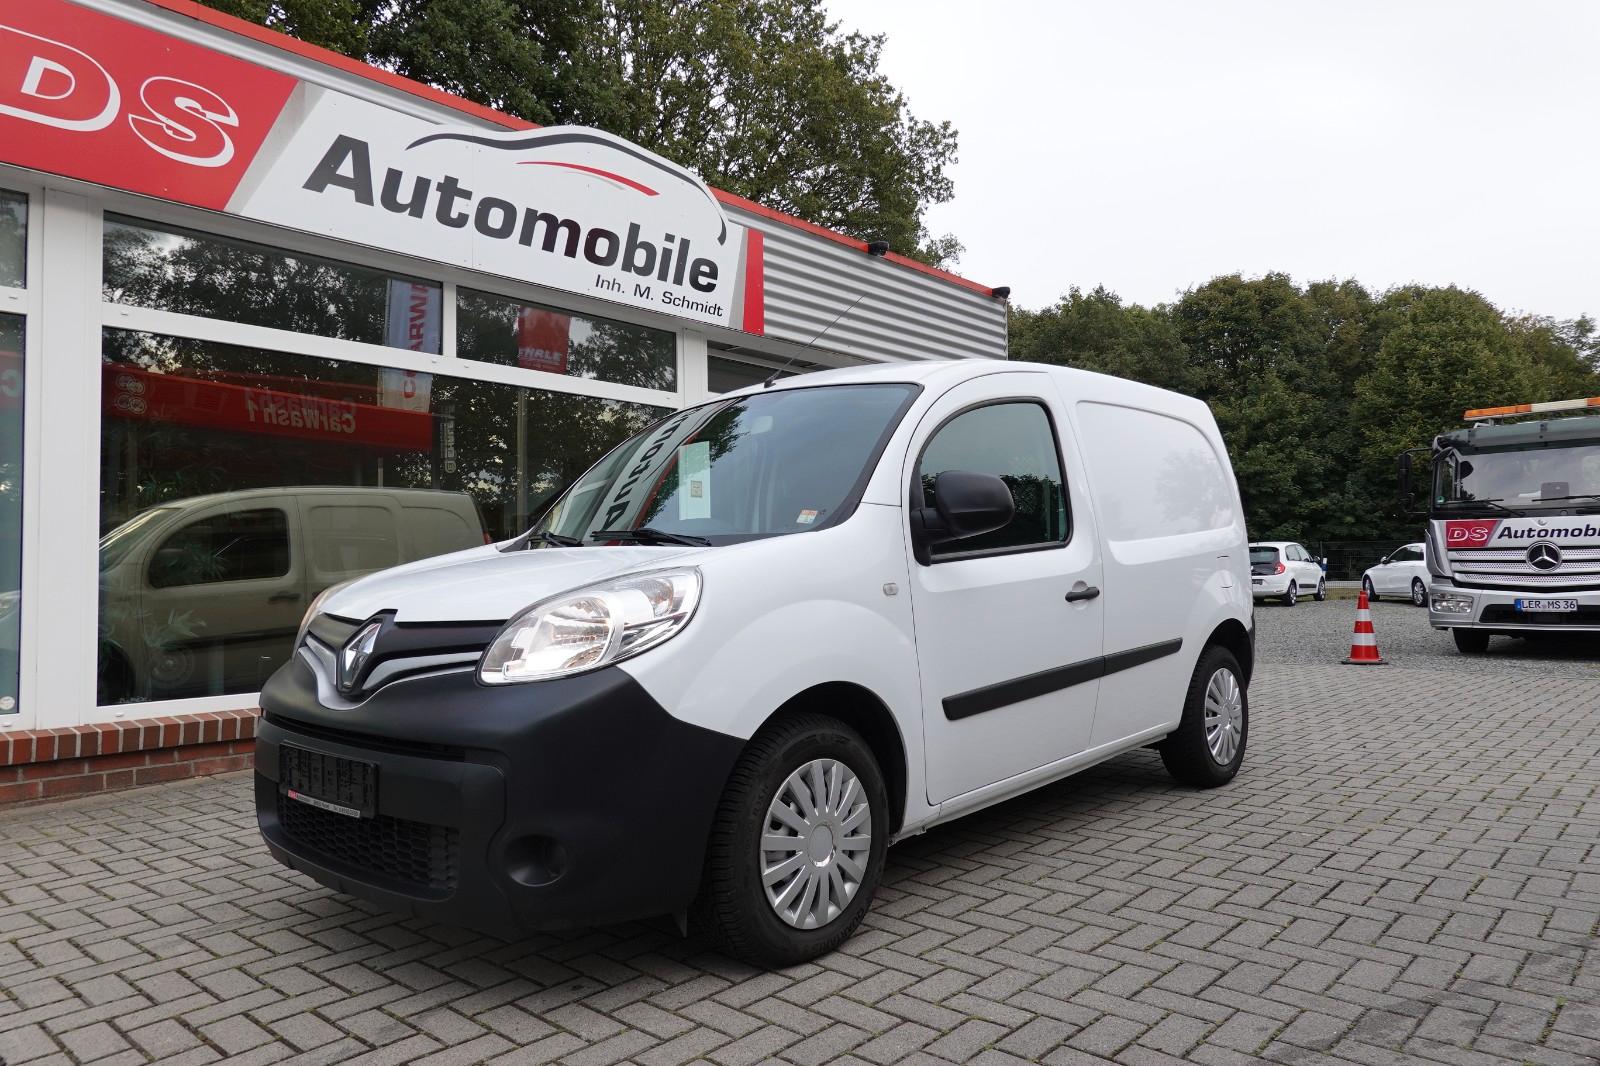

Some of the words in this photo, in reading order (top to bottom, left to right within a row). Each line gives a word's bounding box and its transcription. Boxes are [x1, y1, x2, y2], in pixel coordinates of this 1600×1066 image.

[0, 24, 240, 168] DS
[301, 133, 719, 293] Automobile
[595, 274, 625, 294] Inh.
[633, 283, 654, 301] M.
[661, 290, 723, 317] Schmidt
[1447, 526, 1489, 542] DS
[1521, 600, 1541, 609] LER
[1547, 600, 1561, 610] MS
[1563, 600, 1576, 610] 36
